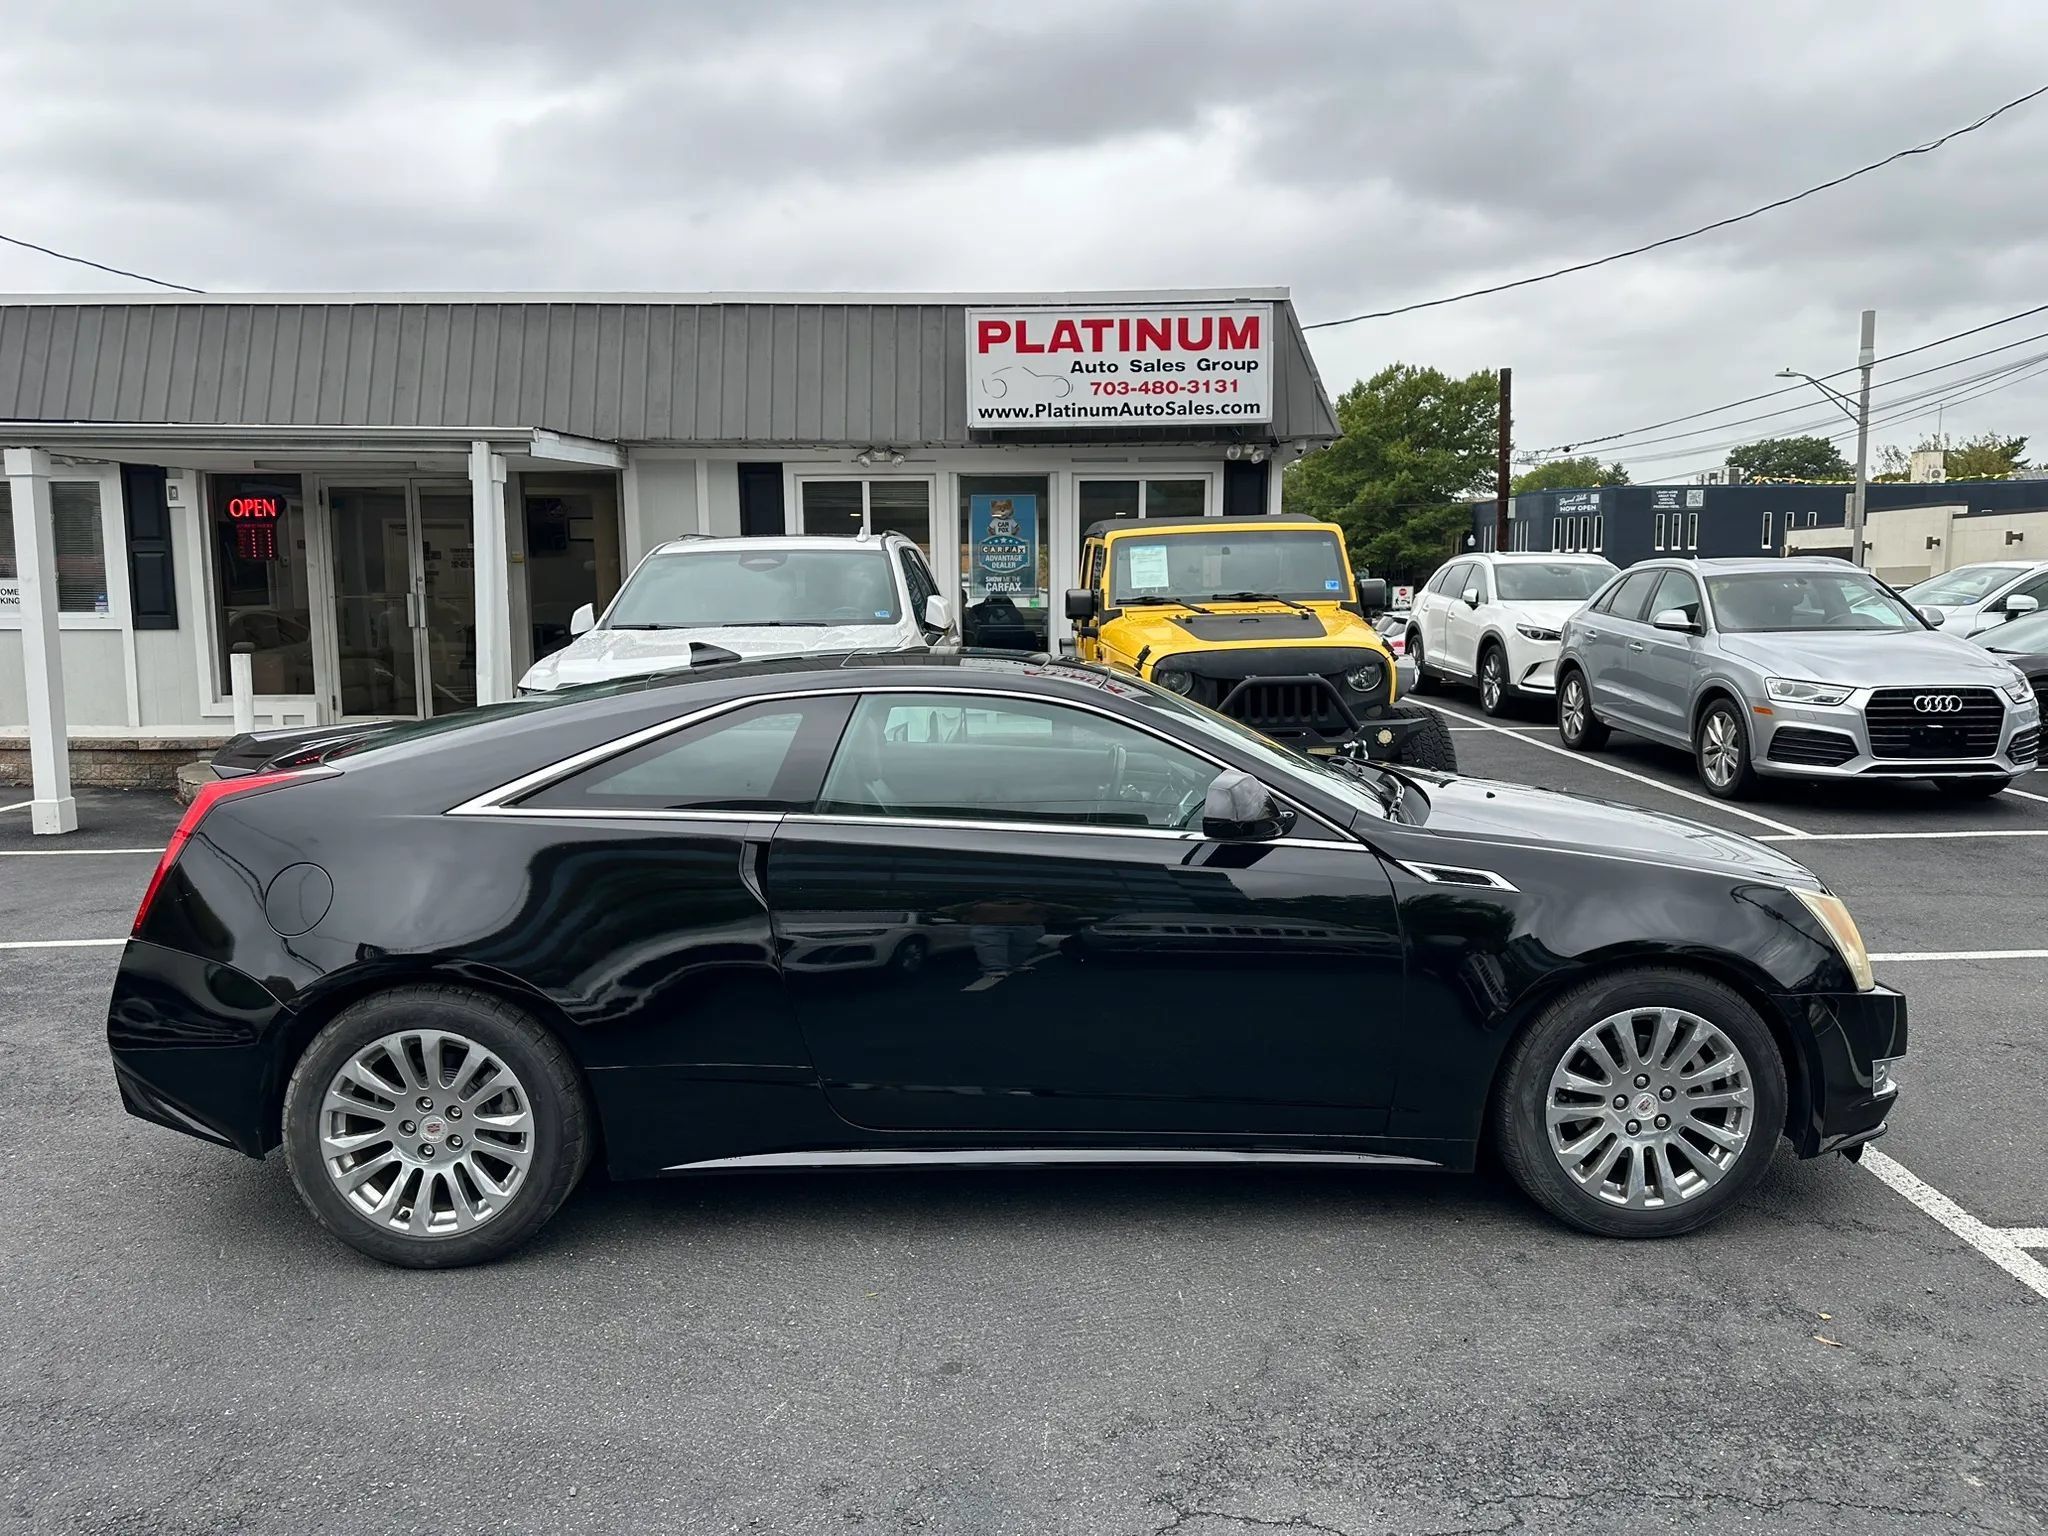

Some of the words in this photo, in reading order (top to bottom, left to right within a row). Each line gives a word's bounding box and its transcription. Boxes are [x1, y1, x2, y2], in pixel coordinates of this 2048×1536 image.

[977, 316, 1260, 354] PLATINUM
[1070, 360, 1119, 374] Auto
[1129, 359, 1186, 373] Sales
[1196, 358, 1259, 373] Group
[1090, 379, 1239, 396] 703-480-3131
[978, 400, 1261, 419] www.PlatinumAutoSales.com
[230, 499, 276, 517] OPEN
[0, 588, 20, 596] OME
[985, 583, 1022, 592] CARFAX
[0, 597, 21, 605] KING
